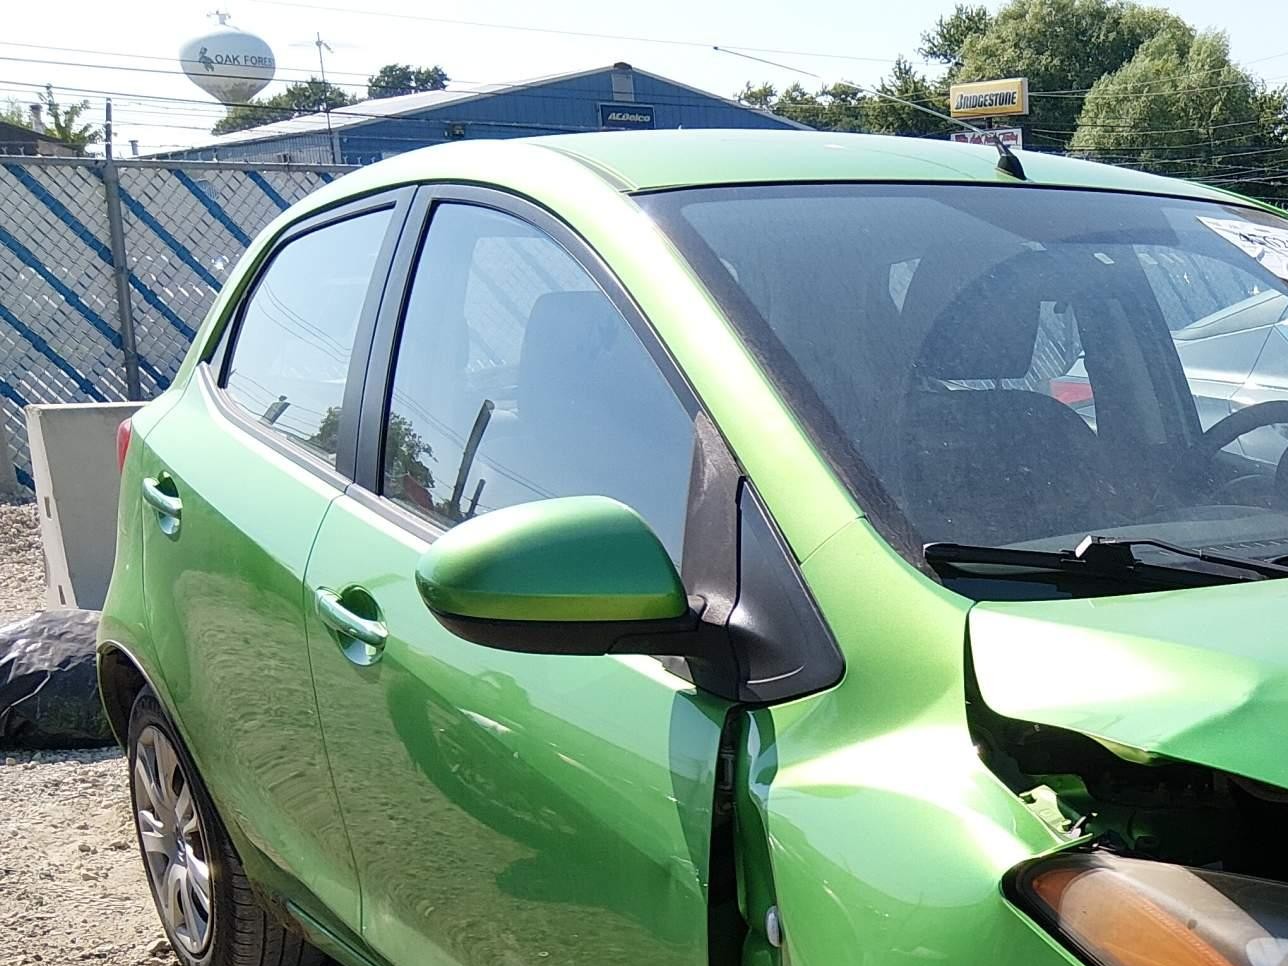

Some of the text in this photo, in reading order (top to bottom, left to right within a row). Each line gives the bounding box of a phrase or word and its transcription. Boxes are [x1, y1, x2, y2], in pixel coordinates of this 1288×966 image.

[215, 54, 273, 67] OAK FORES
[955, 91, 1017, 110] BRIDGESTONE
[608, 112, 650, 122] ACDelco
